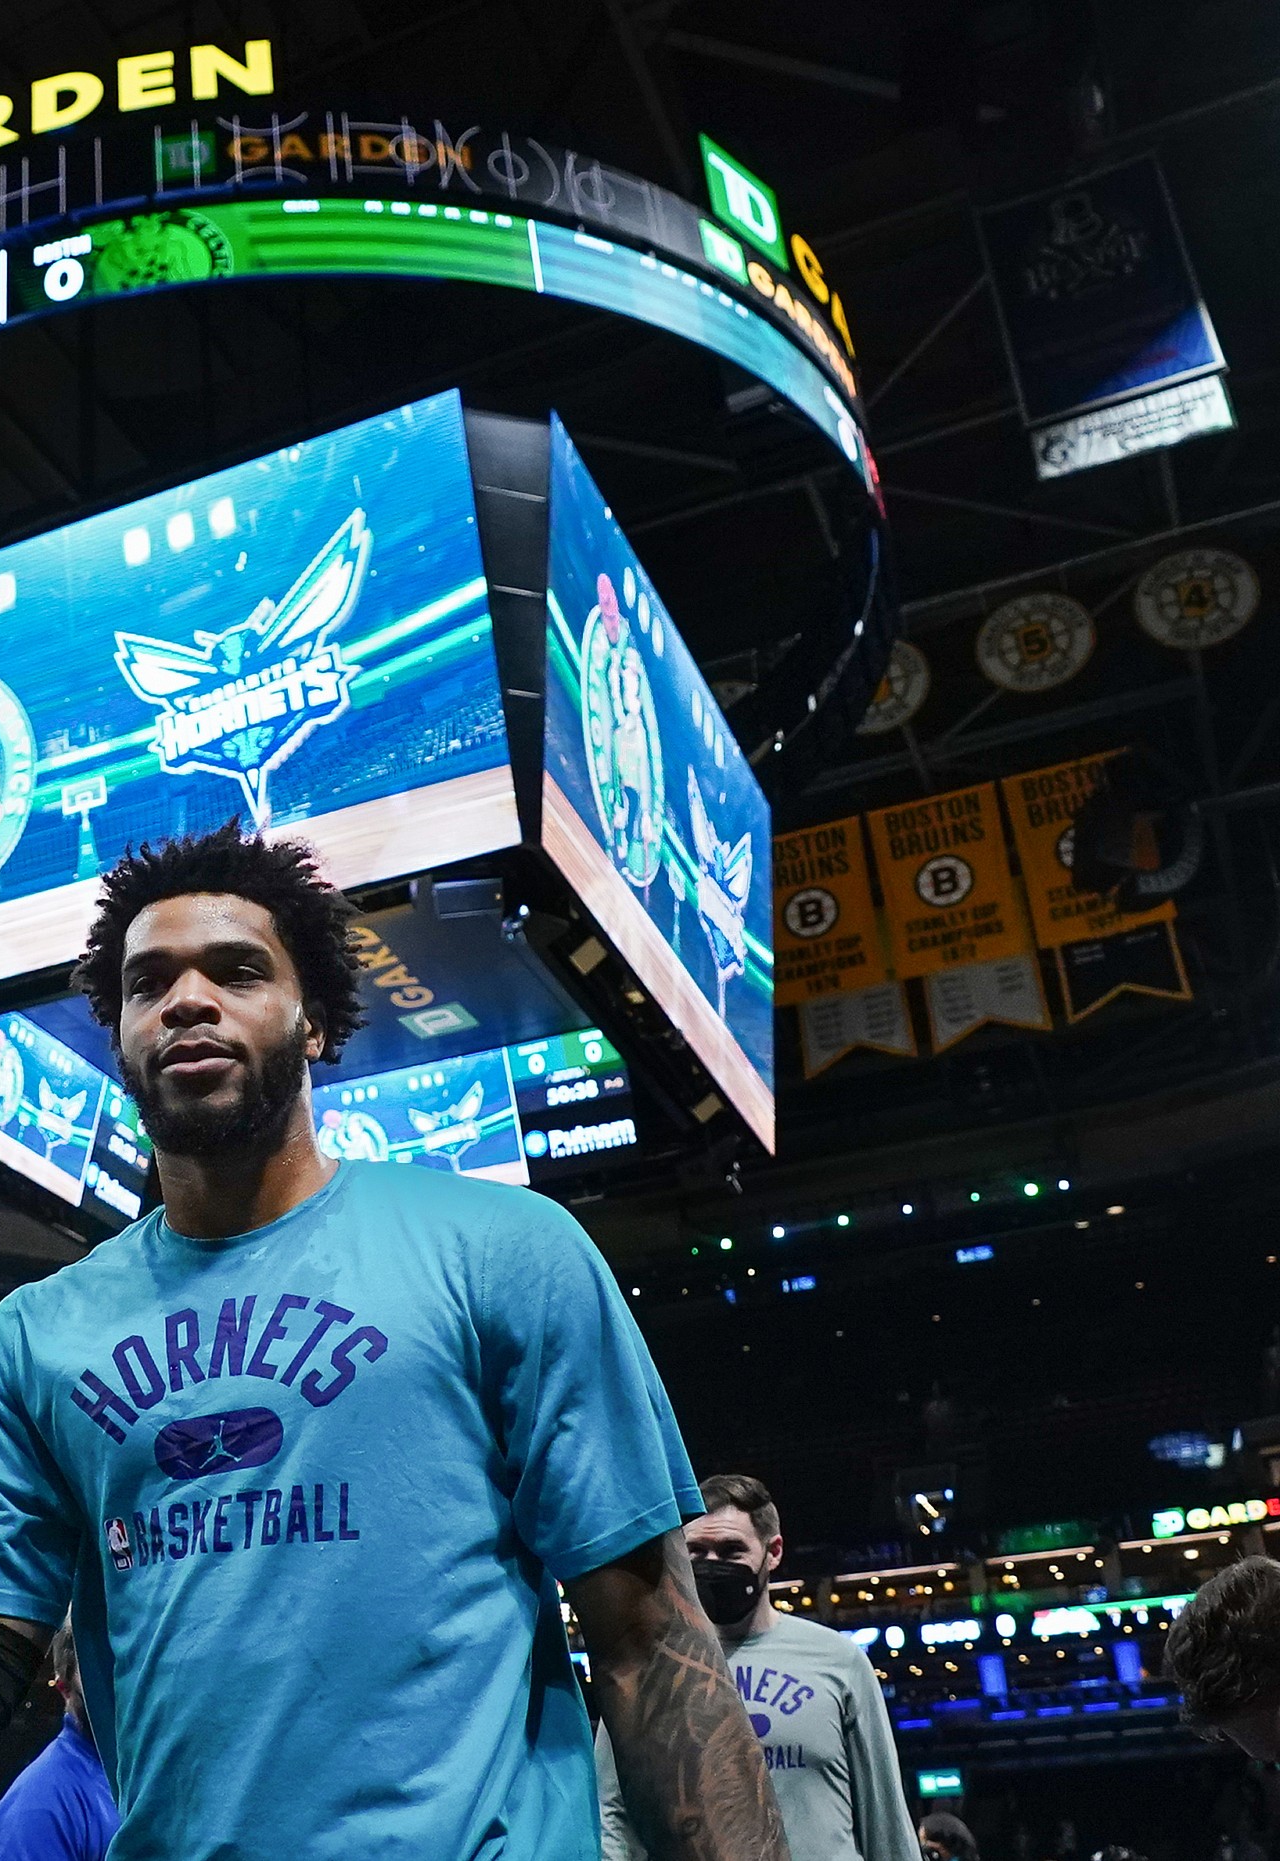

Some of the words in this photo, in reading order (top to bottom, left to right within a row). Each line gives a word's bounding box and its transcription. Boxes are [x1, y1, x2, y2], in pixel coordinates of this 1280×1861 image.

[707, 152, 777, 244] TD
[44, 258, 84, 301] 0
[161, 653, 341, 761] HORNETS
[884, 792, 981, 833] BOSTON
[891, 816, 985, 860] BRUINS
[932, 867, 959, 896] B
[798, 900, 824, 928] B
[527, 1053, 546, 1075] 0
[585, 1041, 603, 1063] 0
[69, 1294, 389, 1446] HORNETS
[133, 1482, 361, 1567] BASKETBALL
[735, 1665, 815, 1715] NETS
[764, 1744, 807, 1770] BALL
